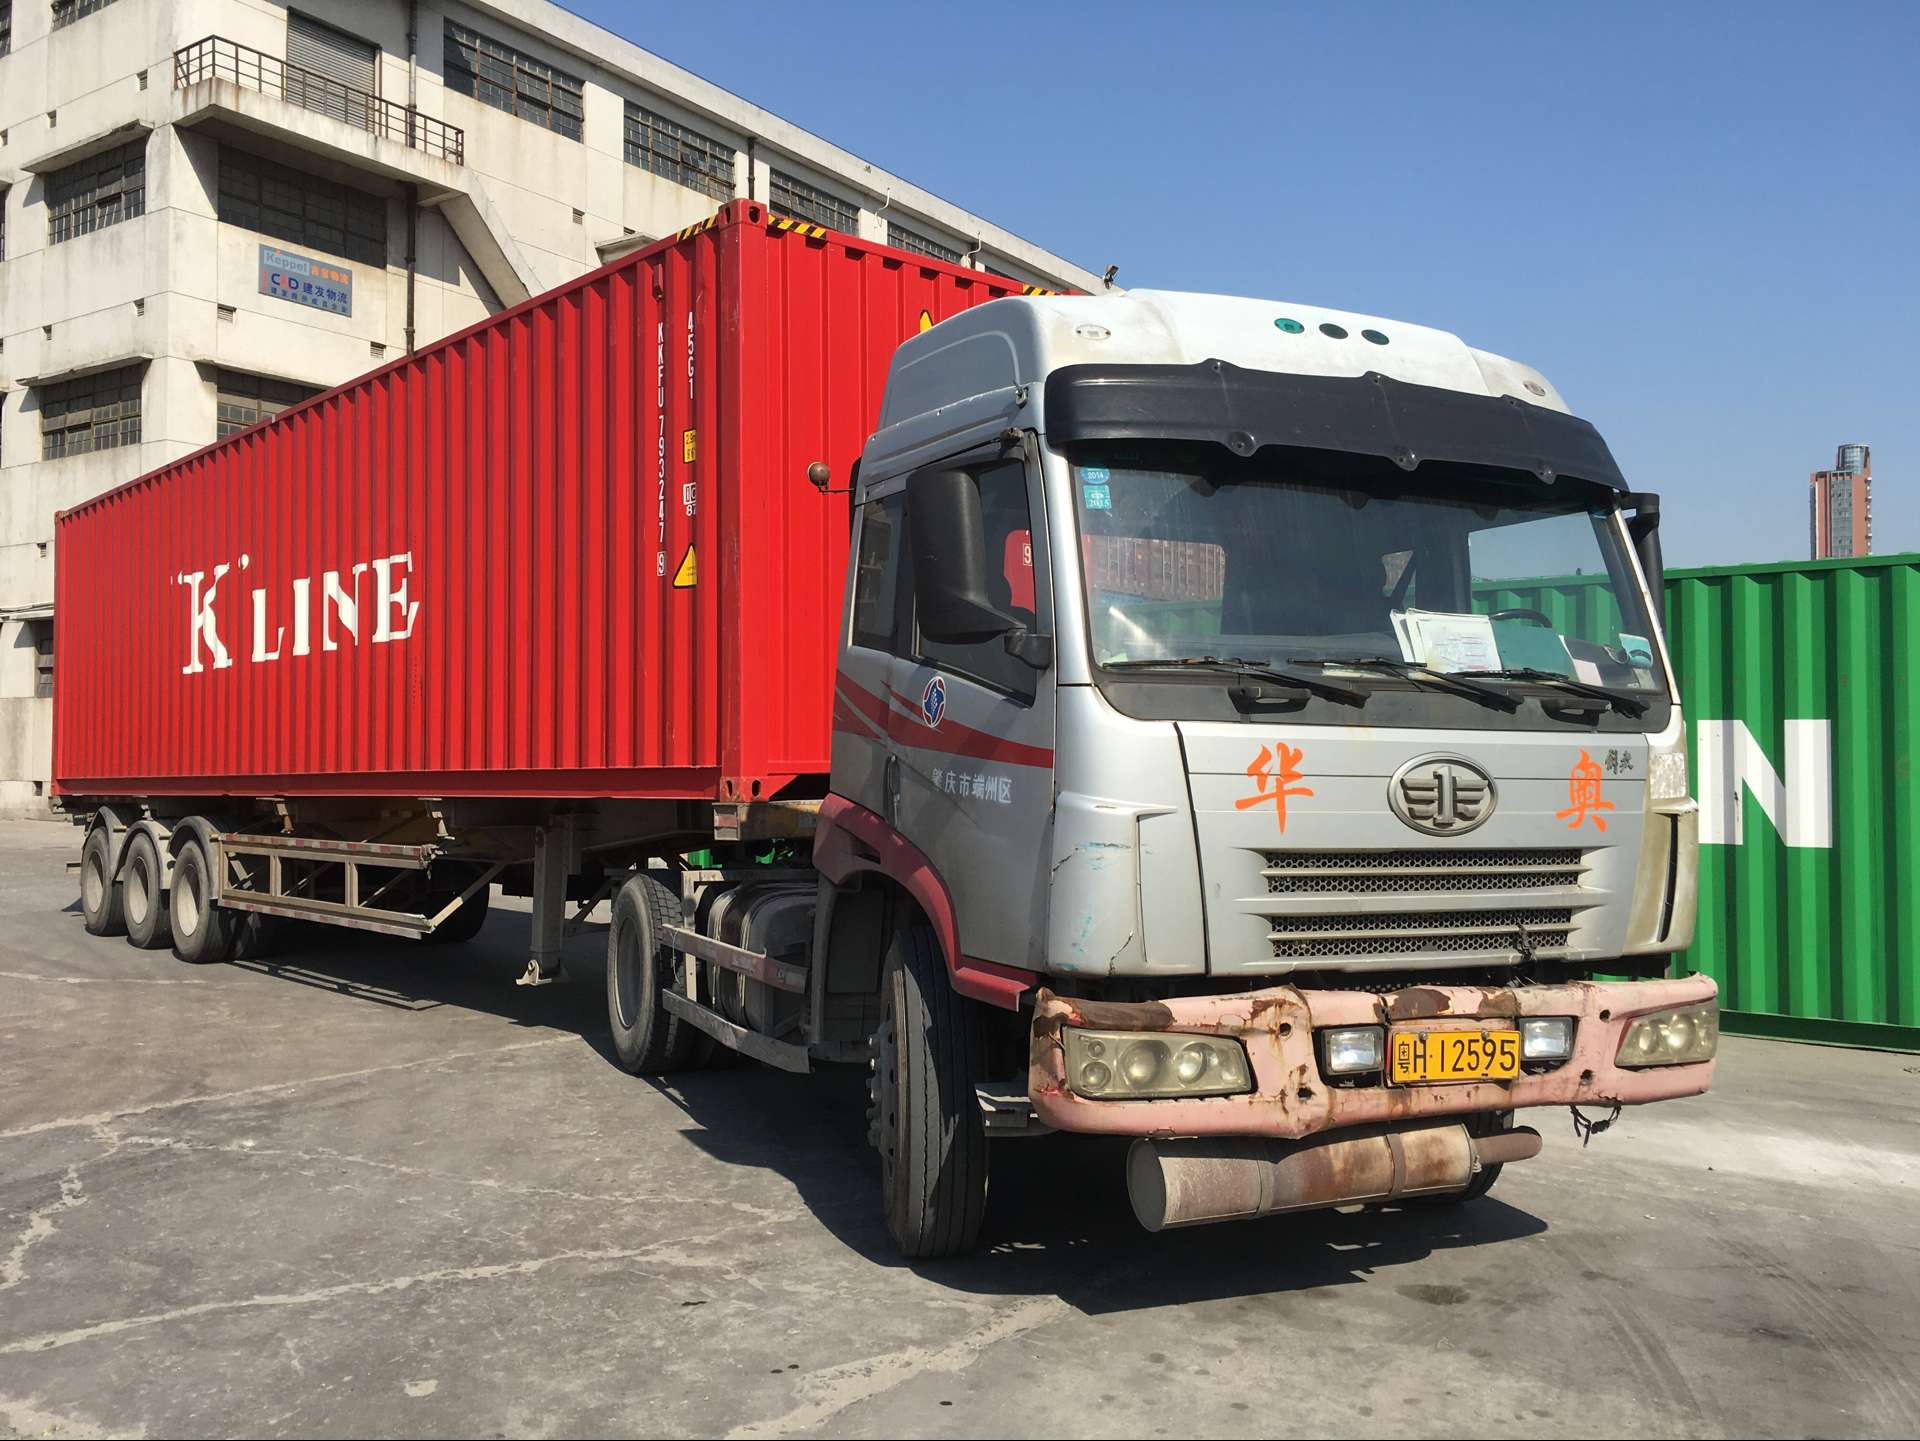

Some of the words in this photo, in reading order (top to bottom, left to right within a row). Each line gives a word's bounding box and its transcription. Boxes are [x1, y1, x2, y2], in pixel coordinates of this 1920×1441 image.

[303, 282, 348, 305] 建发物流
[252, 551, 420, 663] LINE
[931, 767, 1012, 804] 肇庆市端州区
[1235, 741, 1313, 834] 华
[1556, 748, 1616, 833] 奥
